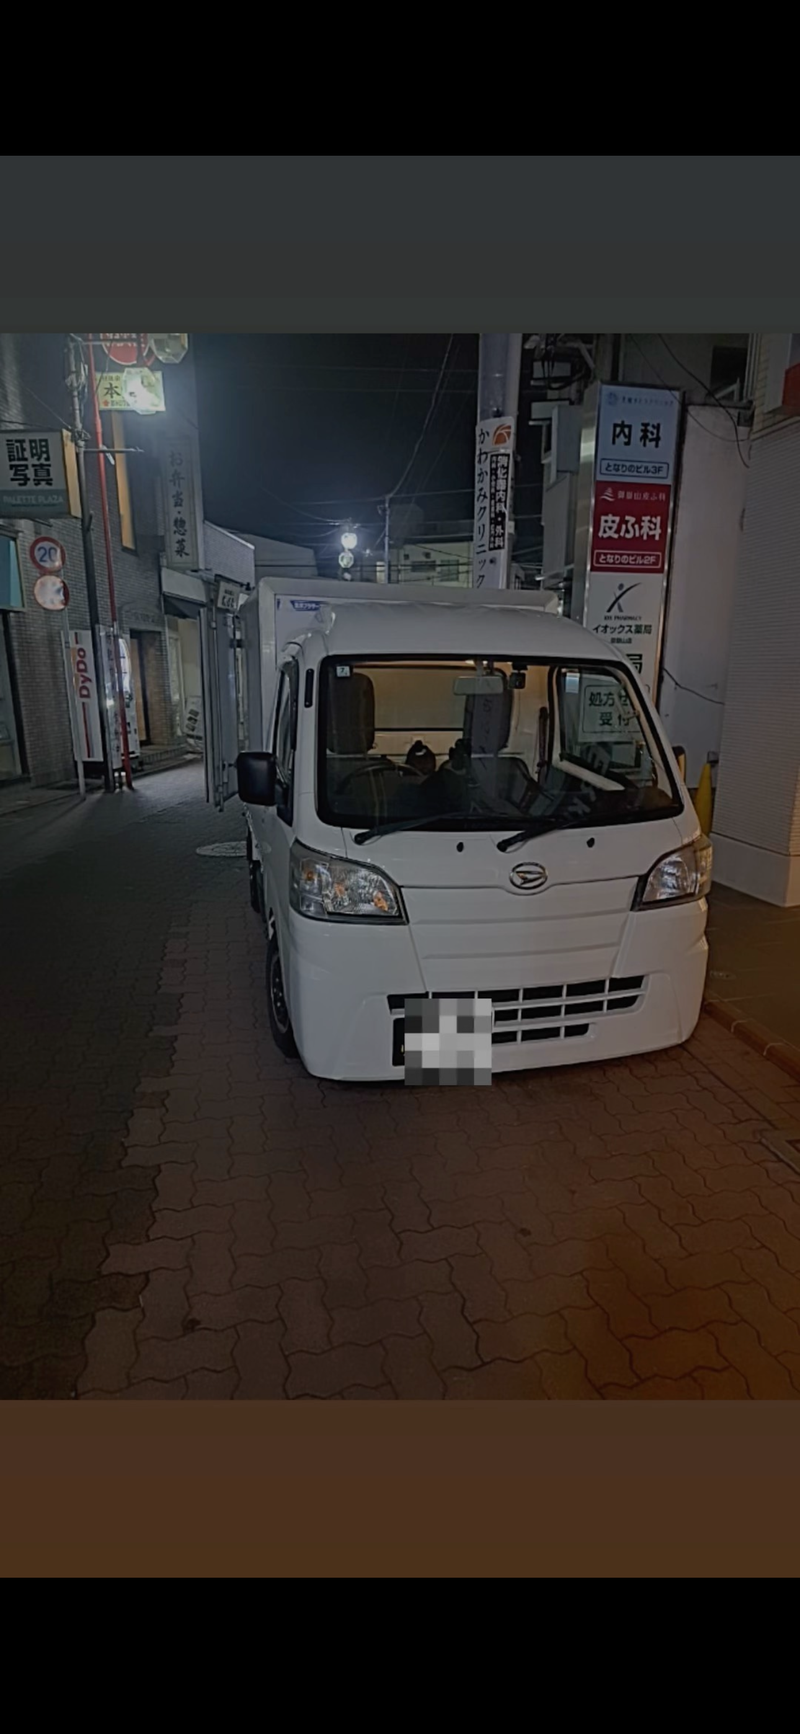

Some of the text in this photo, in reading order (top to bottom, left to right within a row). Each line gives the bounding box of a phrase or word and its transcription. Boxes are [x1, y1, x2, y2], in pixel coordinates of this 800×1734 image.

[611, 420, 661, 449] 内科
[6, 438, 50, 463] 証明
[9, 463, 53, 487] 写真
[605, 462, 664, 475] となりのビル3F
[3, 494, 63, 504] PALETTE PLAZA
[476, 428, 489, 588] かわかみクリニック
[598, 513, 662, 541] 皮ふ科
[36, 546, 59, 563] 20
[599, 553, 657, 565] となりのビル2F
[592, 624, 652, 636] イオックス薬局
[76, 647, 93, 699] DyDo
